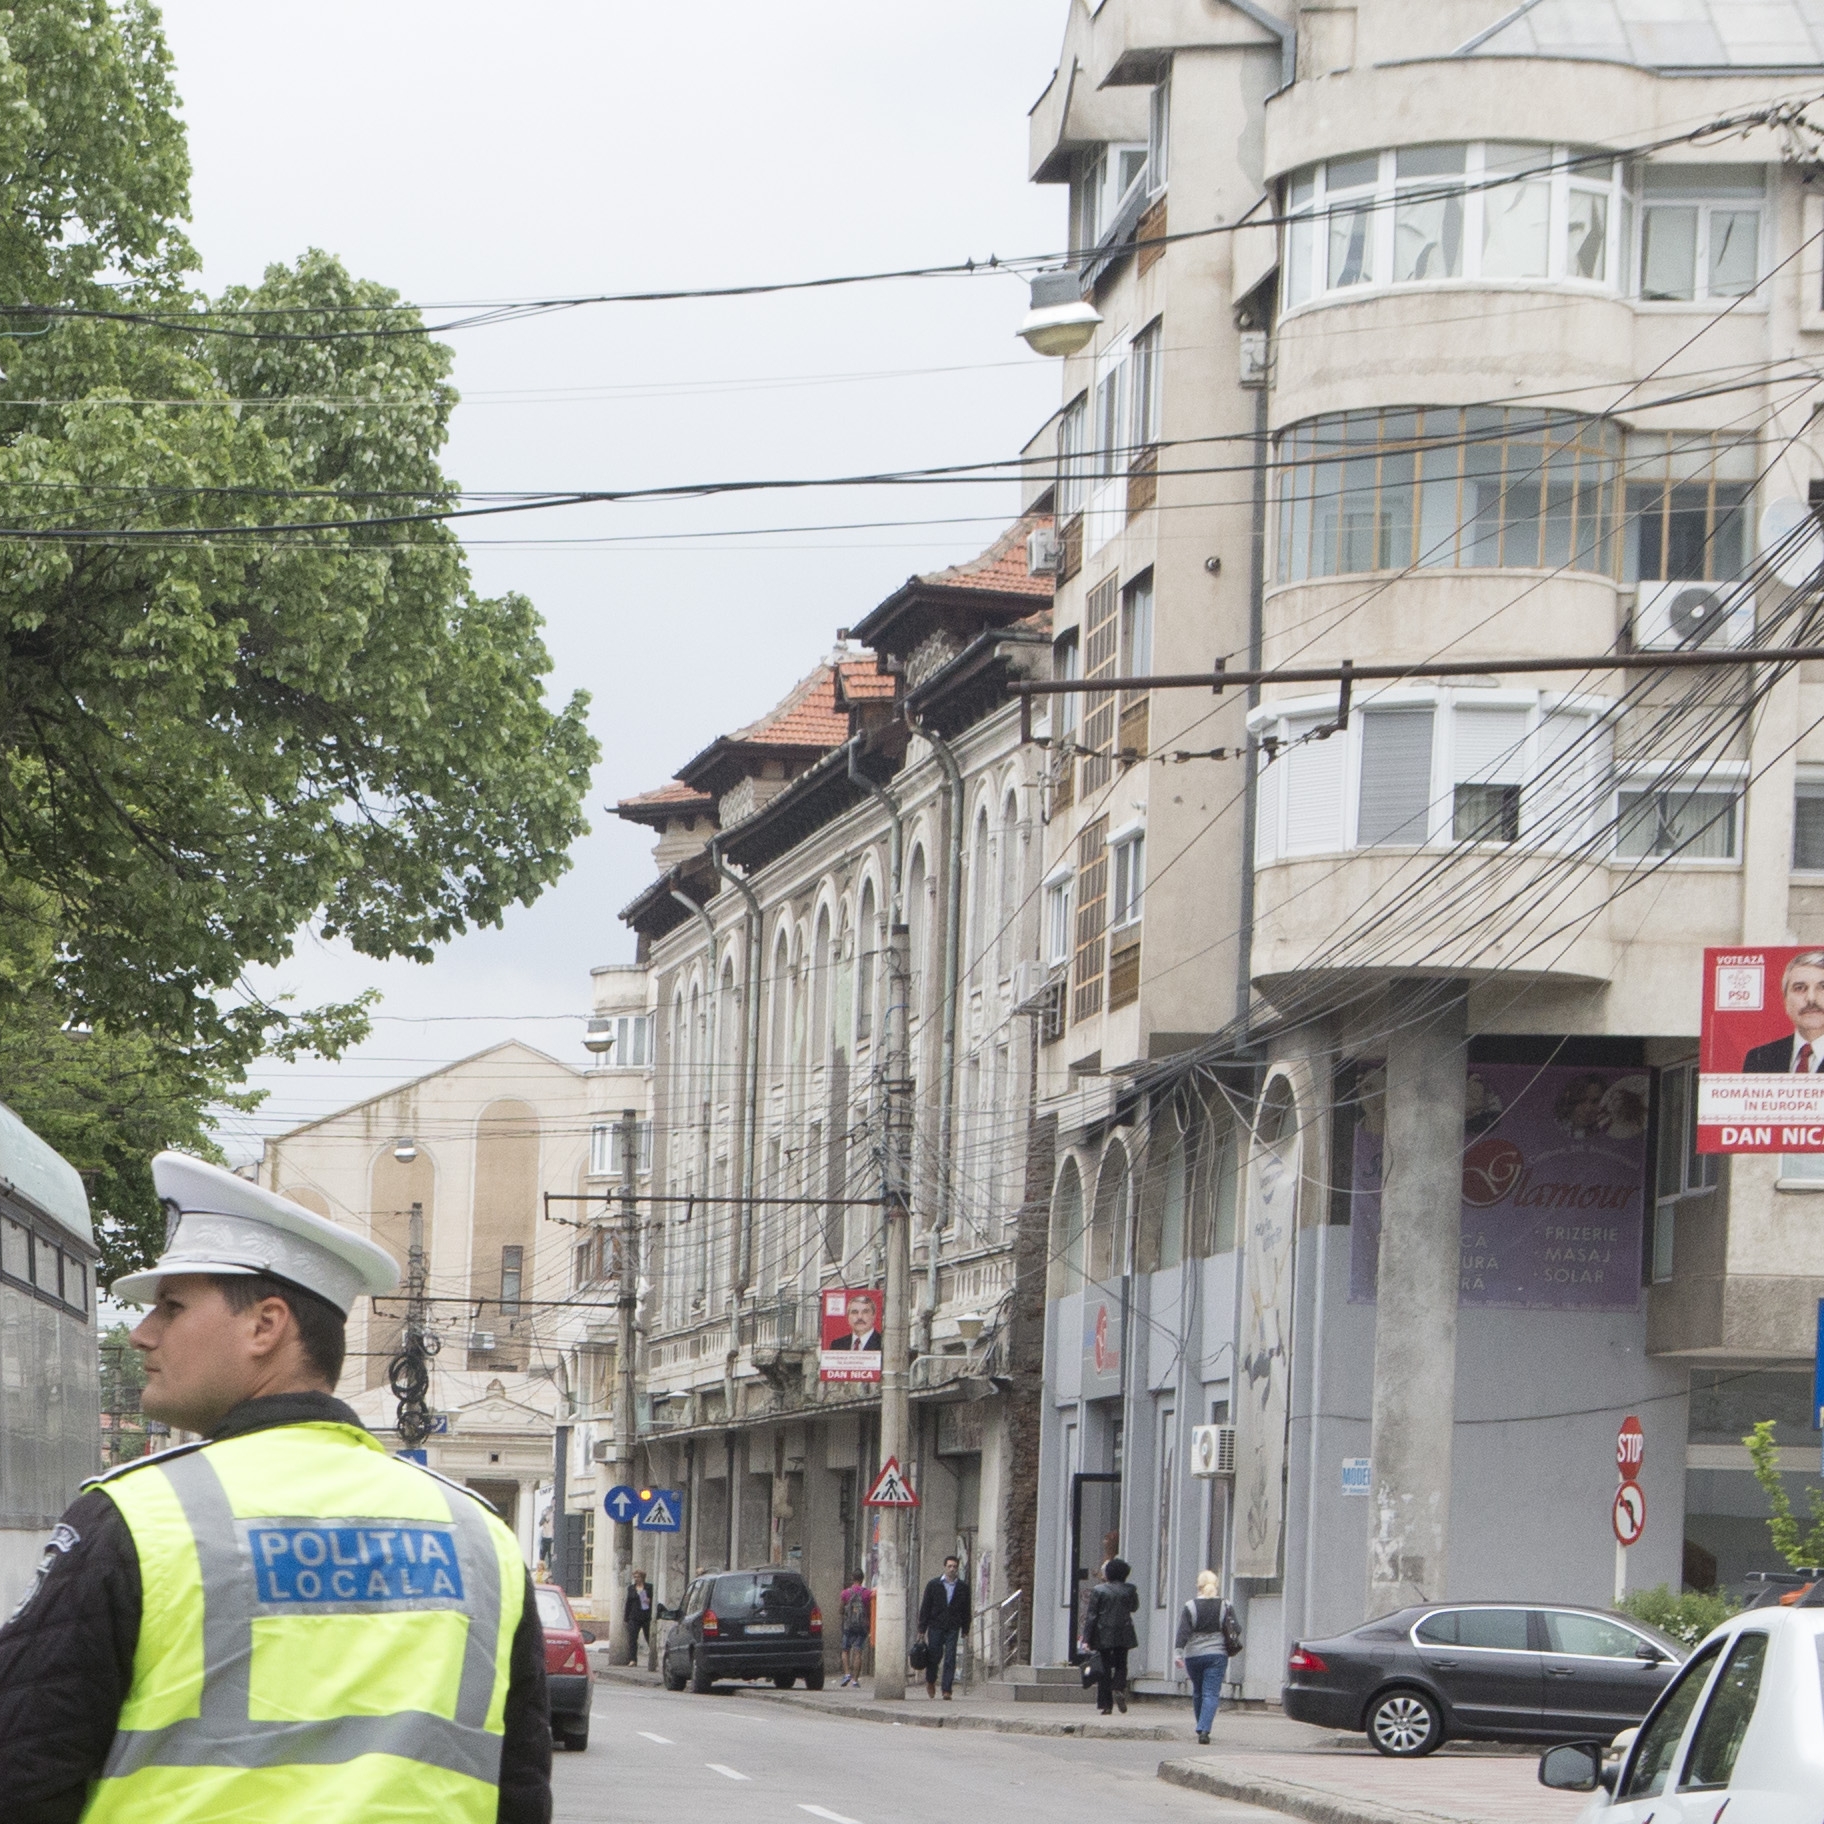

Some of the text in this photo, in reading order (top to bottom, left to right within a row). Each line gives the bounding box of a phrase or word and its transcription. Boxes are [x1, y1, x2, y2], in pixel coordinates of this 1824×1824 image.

[1728, 990, 1751, 1001] PSD
[1711, 1086, 1773, 1099] ROMÂNIA
[1761, 1101, 1817, 1111] EUROPA!
[1721, 1126, 1824, 1146] DAN NIC
[1545, 1226, 1618, 1242] FRIZERIE
[1545, 1248, 1611, 1264] MASAJ
[1545, 1269, 1604, 1284] SOLAR
[827, 1370, 874, 1379] DAN NICA
[1617, 1433, 1644, 1463] STOP
[259, 1530, 451, 1567] POLITIA
[268, 1568, 456, 1599] LOCALA
